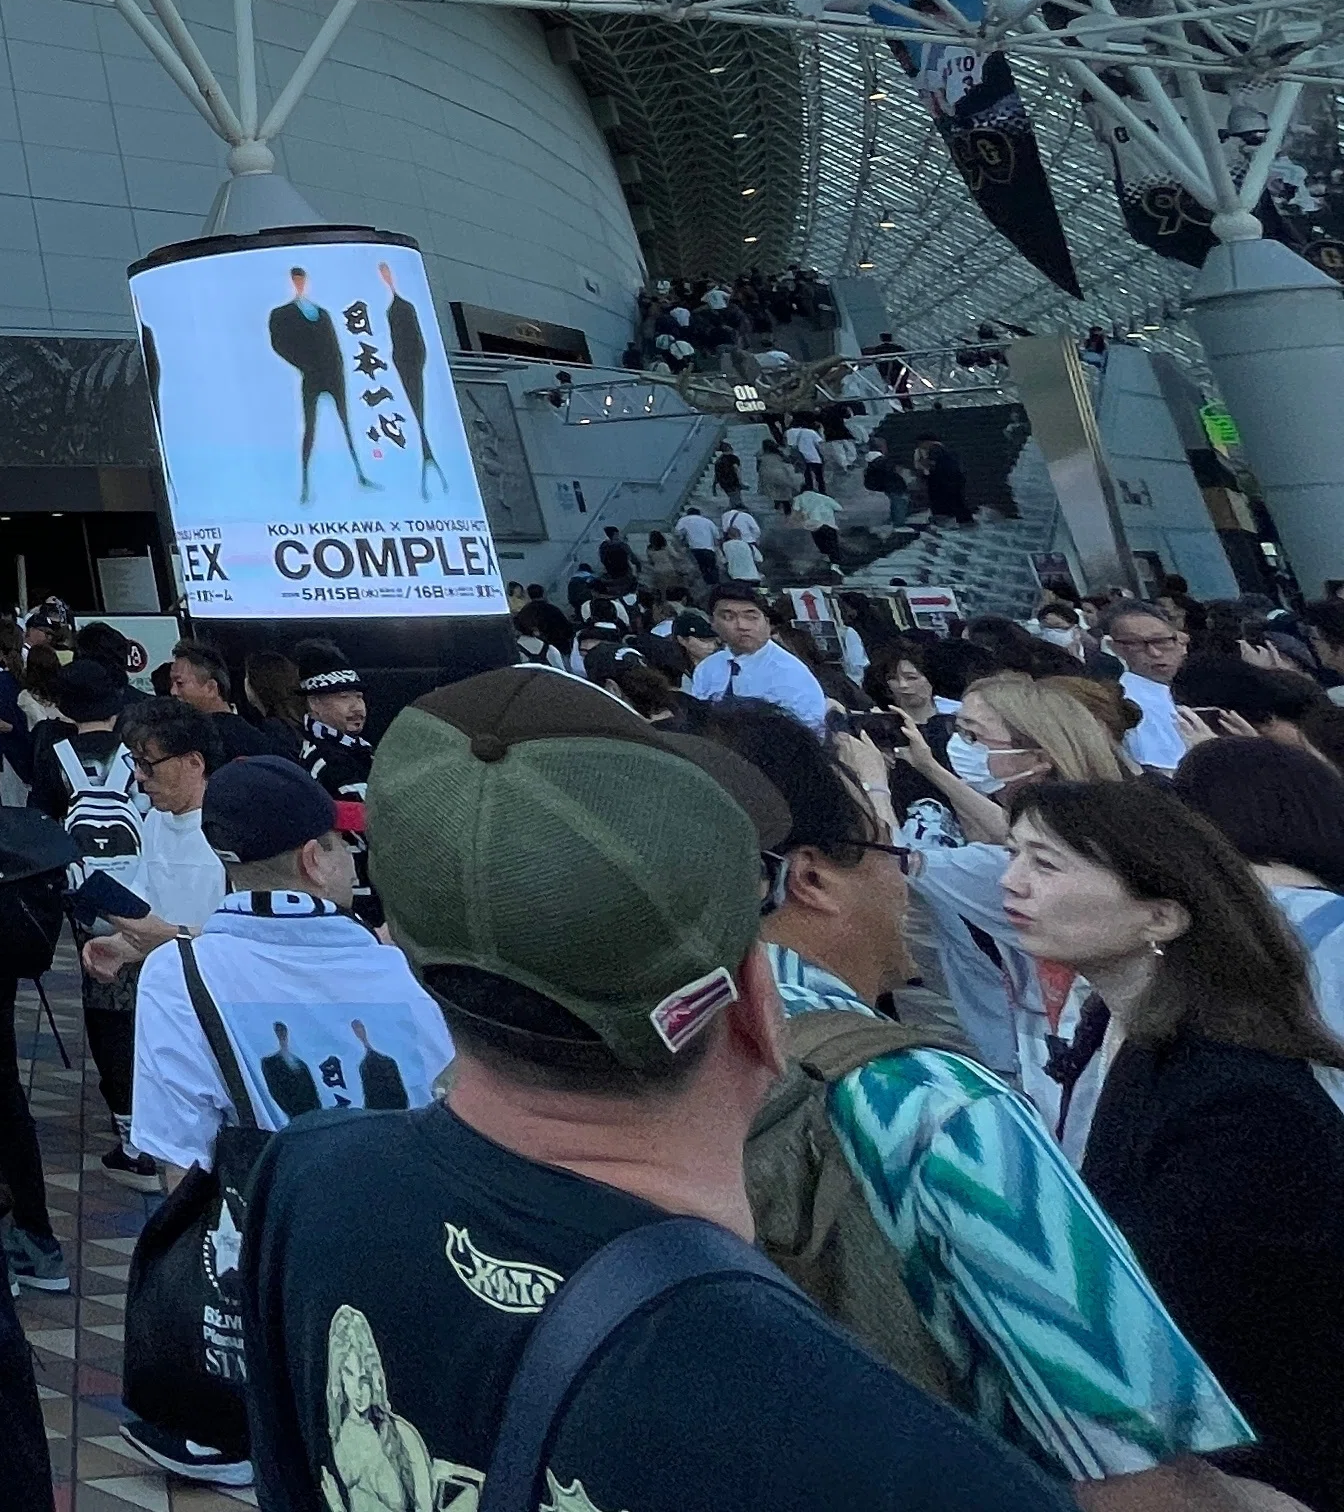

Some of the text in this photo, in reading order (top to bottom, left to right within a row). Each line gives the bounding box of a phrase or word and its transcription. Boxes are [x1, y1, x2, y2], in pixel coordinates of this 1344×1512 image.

[344, 301, 407, 449] 日本一心
[268, 524, 304, 536] KOJI
[309, 521, 385, 535] KIKKAWA
[404, 520, 470, 533] TOMOYASU
[184, 543, 230, 582] EX
[274, 536, 499, 581] COMPLEX
